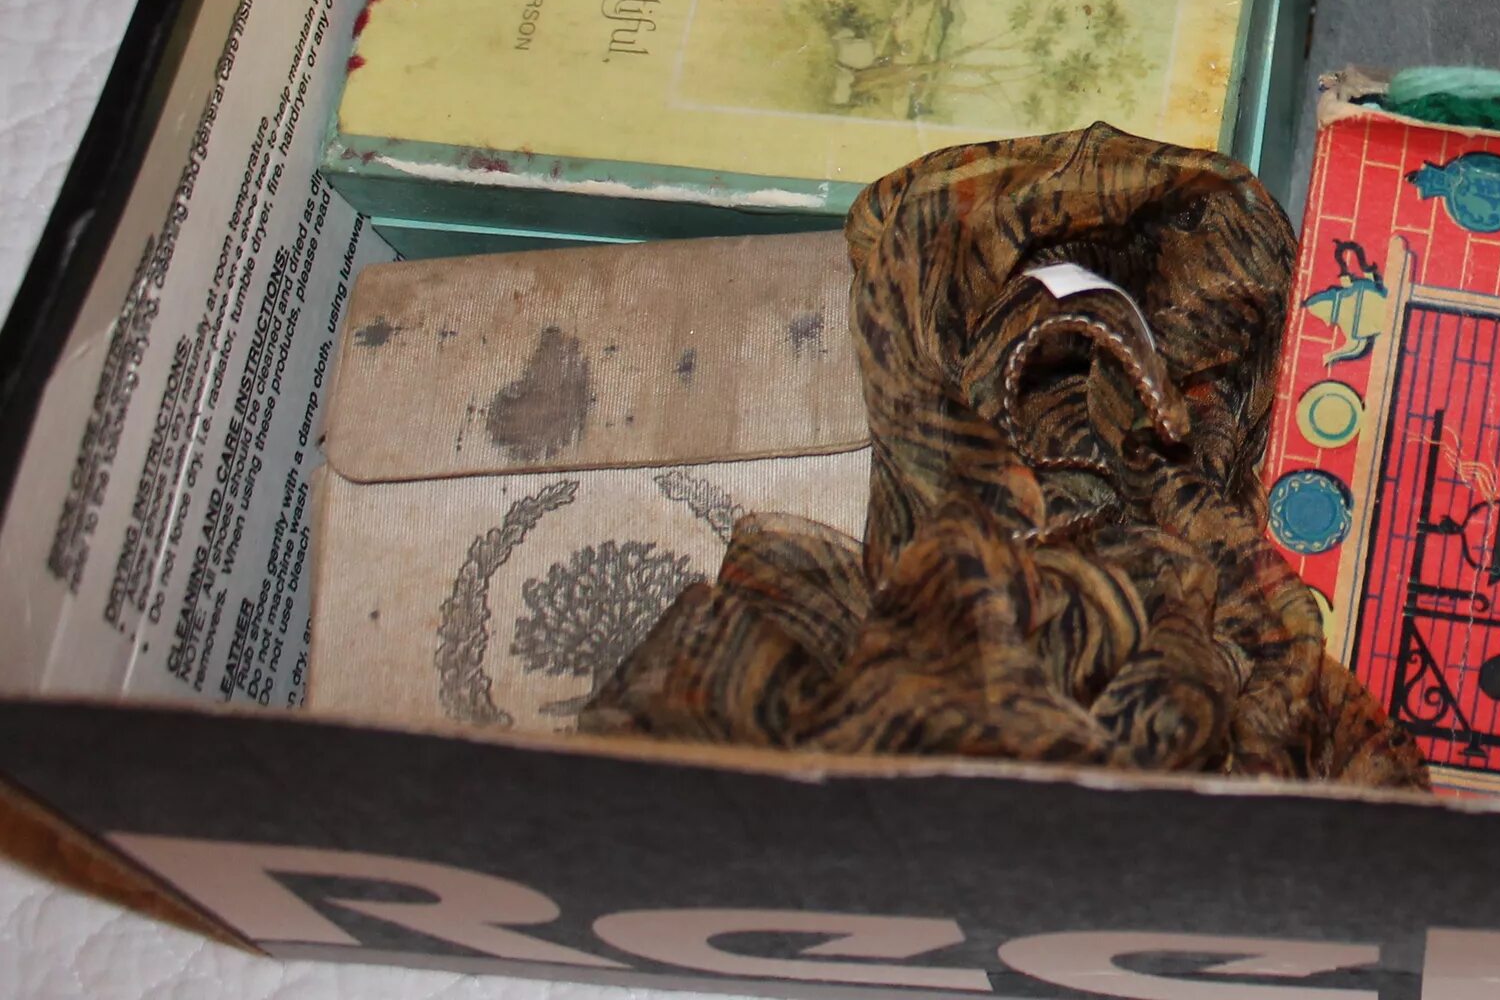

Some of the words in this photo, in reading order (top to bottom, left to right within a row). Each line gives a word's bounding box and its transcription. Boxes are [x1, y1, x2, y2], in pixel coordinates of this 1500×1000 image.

[171, 410, 185, 441] dry
[180, 319, 210, 401] naturally
[206, 289, 216, 310] at
[214, 237, 232, 284] room
[229, 117, 269, 231] temperature
[239, 196, 257, 241] shoe
[255, 153, 270, 187] tree
[267, 128, 277, 147] to
[273, 87, 291, 126] help
[286, 7, 315, 82] maintain
[104, 525, 138, 624] DRYING
[130, 334, 191, 520] INSTRUCTIONS:
[150, 590, 163, 623] Do
[160, 551, 173, 585] not
[171, 492, 190, 546] force
[186, 451, 202, 488] dry,
[207, 328, 236, 409] radiator,
[231, 258, 255, 322] tumble
[250, 202, 271, 253] dryer,
[267, 163, 283, 194] fire,
[279, 74, 310, 155] hairdryer,
[306, 46, 317, 67] or
[313, 12, 330, 44] any
[167, 547, 206, 672] CLEANING
[202, 489, 220, 539] AND
[216, 419, 239, 484] CARE
[234, 246, 287, 414] INSTRUCTIONS:
[180, 606, 205, 683] NOTE:
[202, 566, 215, 596] All
[211, 500, 233, 561] shoes
[228, 428, 251, 495] should
[247, 399, 259, 424] be
[255, 317, 281, 394] cleaned
[276, 276, 292, 313] and
[287, 218, 308, 272] dried
[304, 187, 317, 212] as
[194, 586, 226, 693] removers.
[223, 514, 244, 575] When
[240, 455, 261, 511] using
[255, 396, 275, 452] these
[270, 305, 301, 393] products,
[294, 238, 319, 301] please
[312, 190, 330, 234] read
[237, 645, 253, 691] Rub
[250, 578, 270, 642] shoes
[266, 511, 288, 576] gently
[282, 467, 298, 508] with
[297, 391, 318, 448] damp
[312, 338, 332, 388] cloth,
[326, 284, 346, 333] using
[248, 665, 261, 700] Do
[257, 626, 271, 663] not
[266, 538, 293, 625] machine
[289, 481, 307, 534] wash
[260, 670, 274, 707] Do
[269, 631, 283, 668] not
[279, 596, 292, 632] use
[288, 526, 309, 592] bleach
